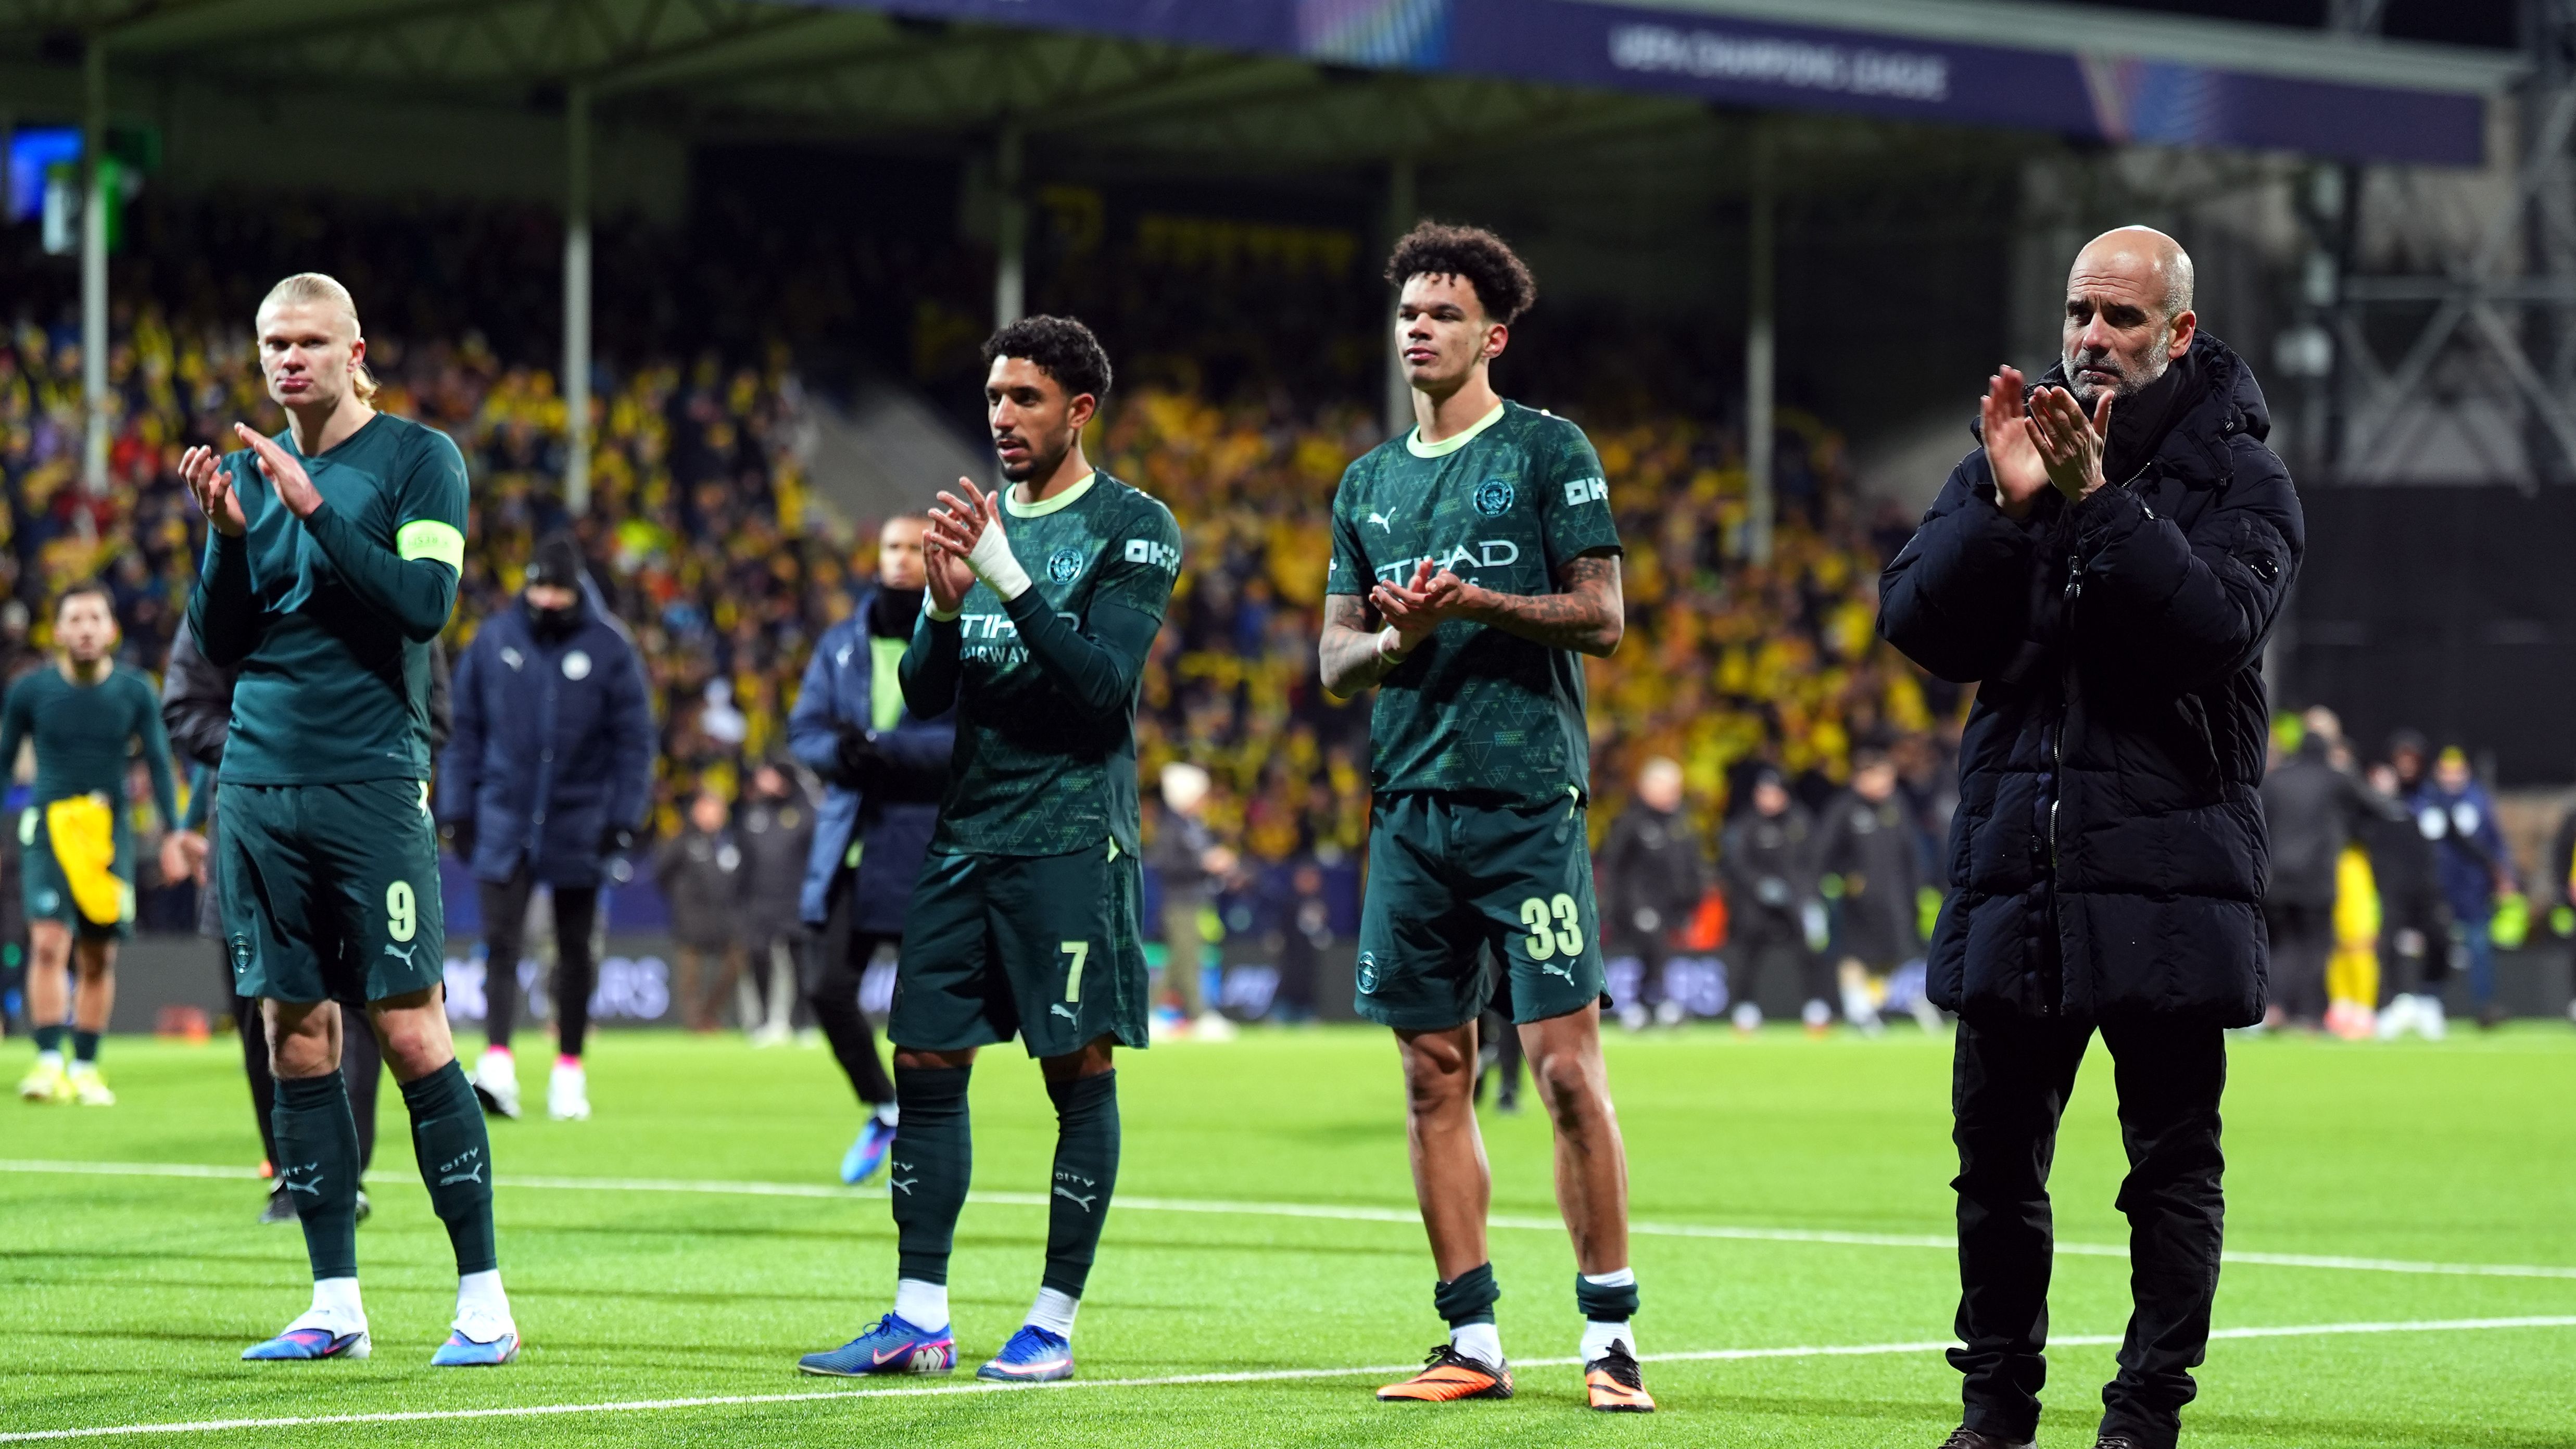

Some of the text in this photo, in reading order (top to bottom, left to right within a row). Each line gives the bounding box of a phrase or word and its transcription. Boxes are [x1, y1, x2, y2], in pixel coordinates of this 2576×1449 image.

[386, 879, 416, 942] 9
[1520, 892, 1584, 961] 33
[1060, 941, 1089, 1003] 7
[440, 1146, 479, 1173] CITY
[1055, 1171, 1096, 1187] CITY
